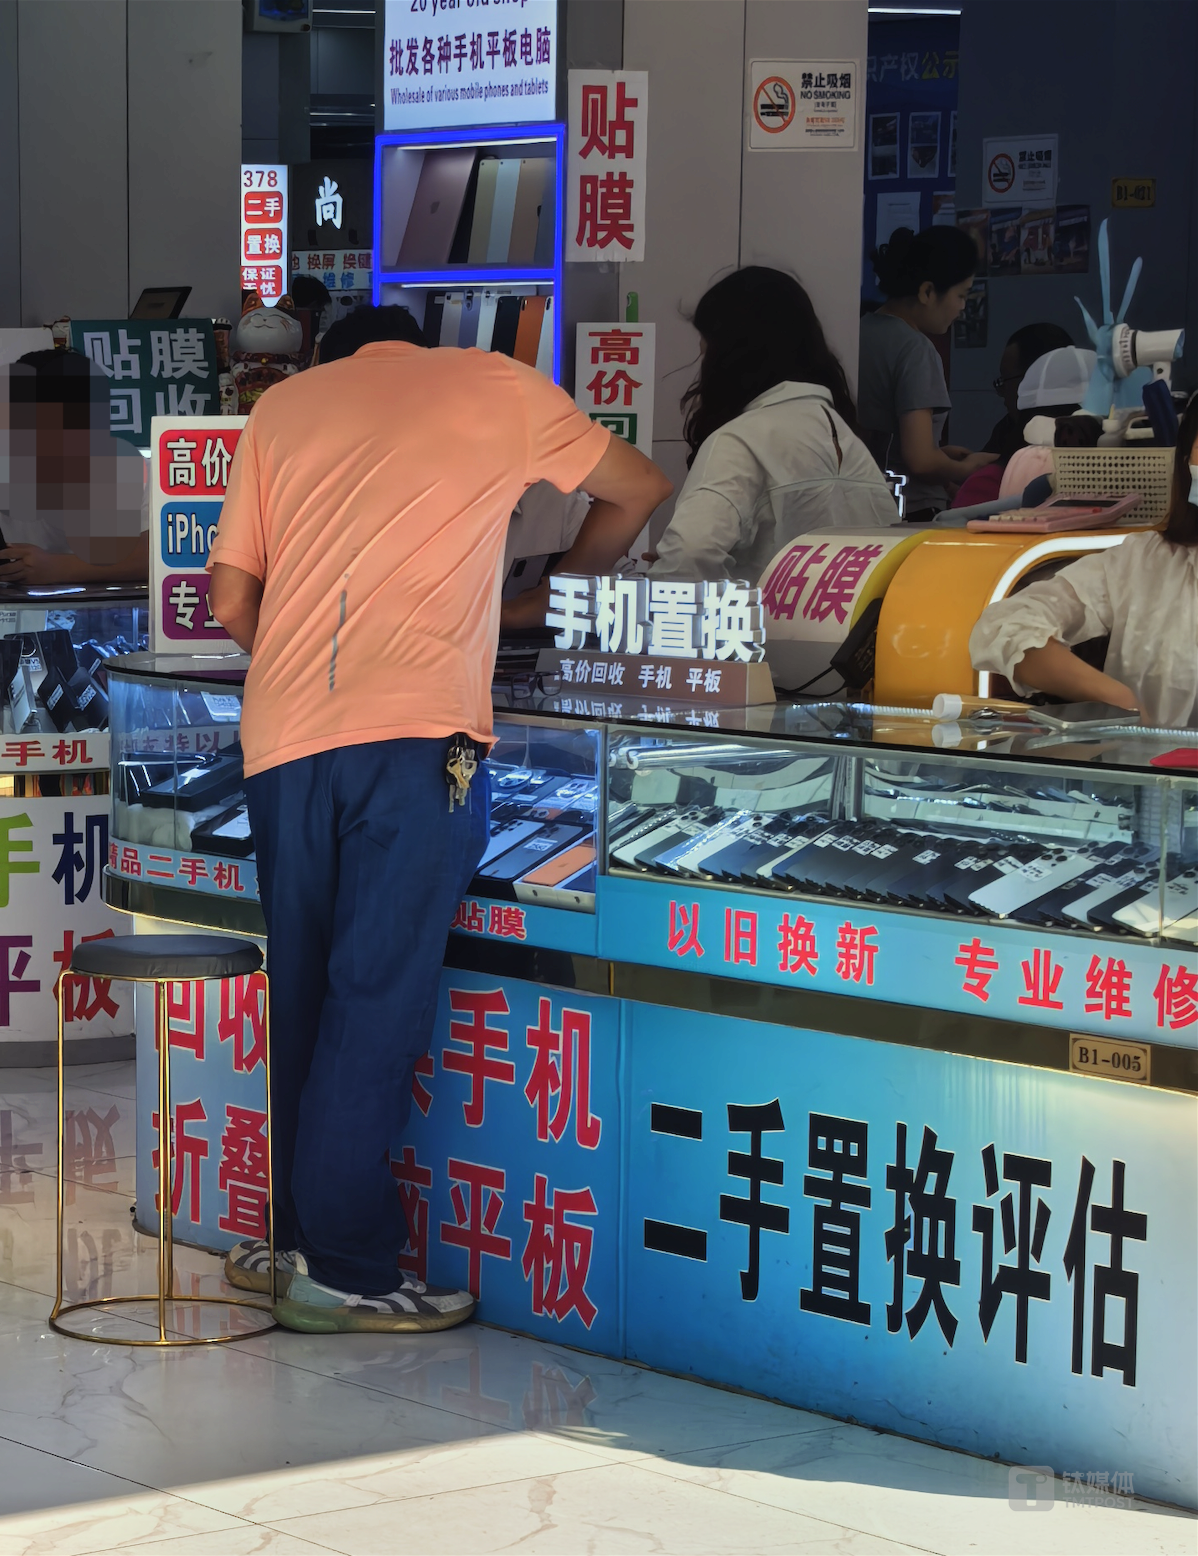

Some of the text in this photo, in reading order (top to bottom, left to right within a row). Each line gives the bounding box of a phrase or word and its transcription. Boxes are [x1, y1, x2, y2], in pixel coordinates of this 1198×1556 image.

[389, 26, 551, 76] 批发各种手机平板电脑
[390, 88, 425, 105] Wholesale
[484, 81, 509, 102] phones
[510, 79, 524, 96] and
[524, 77, 549, 96] tablets
[800, 90, 851, 99] NO SMOKING
[801, 72, 852, 89] 禁止吸烟
[243, 170, 278, 188] 378
[574, 81, 638, 251] 贴膜
[246, 197, 281, 217] 二手
[315, 176, 343, 230] 尚
[246, 234, 281, 255] 置换
[242, 267, 276, 281] 保证
[83, 327, 211, 382] 贴膜
[760, 541, 881, 625] 贴膜
[545, 572, 768, 663] 手机置换
[559, 658, 722, 695] 高价回收 手机 平板
[452, 903, 528, 941] 贴膜
[666, 899, 1198, 1030] 以旧换新 专业维修
[411, 986, 603, 1151] 手机
[1076, 1045, 1143, 1073] B1-005
[643, 1096, 1150, 1389] 二手置换评估
